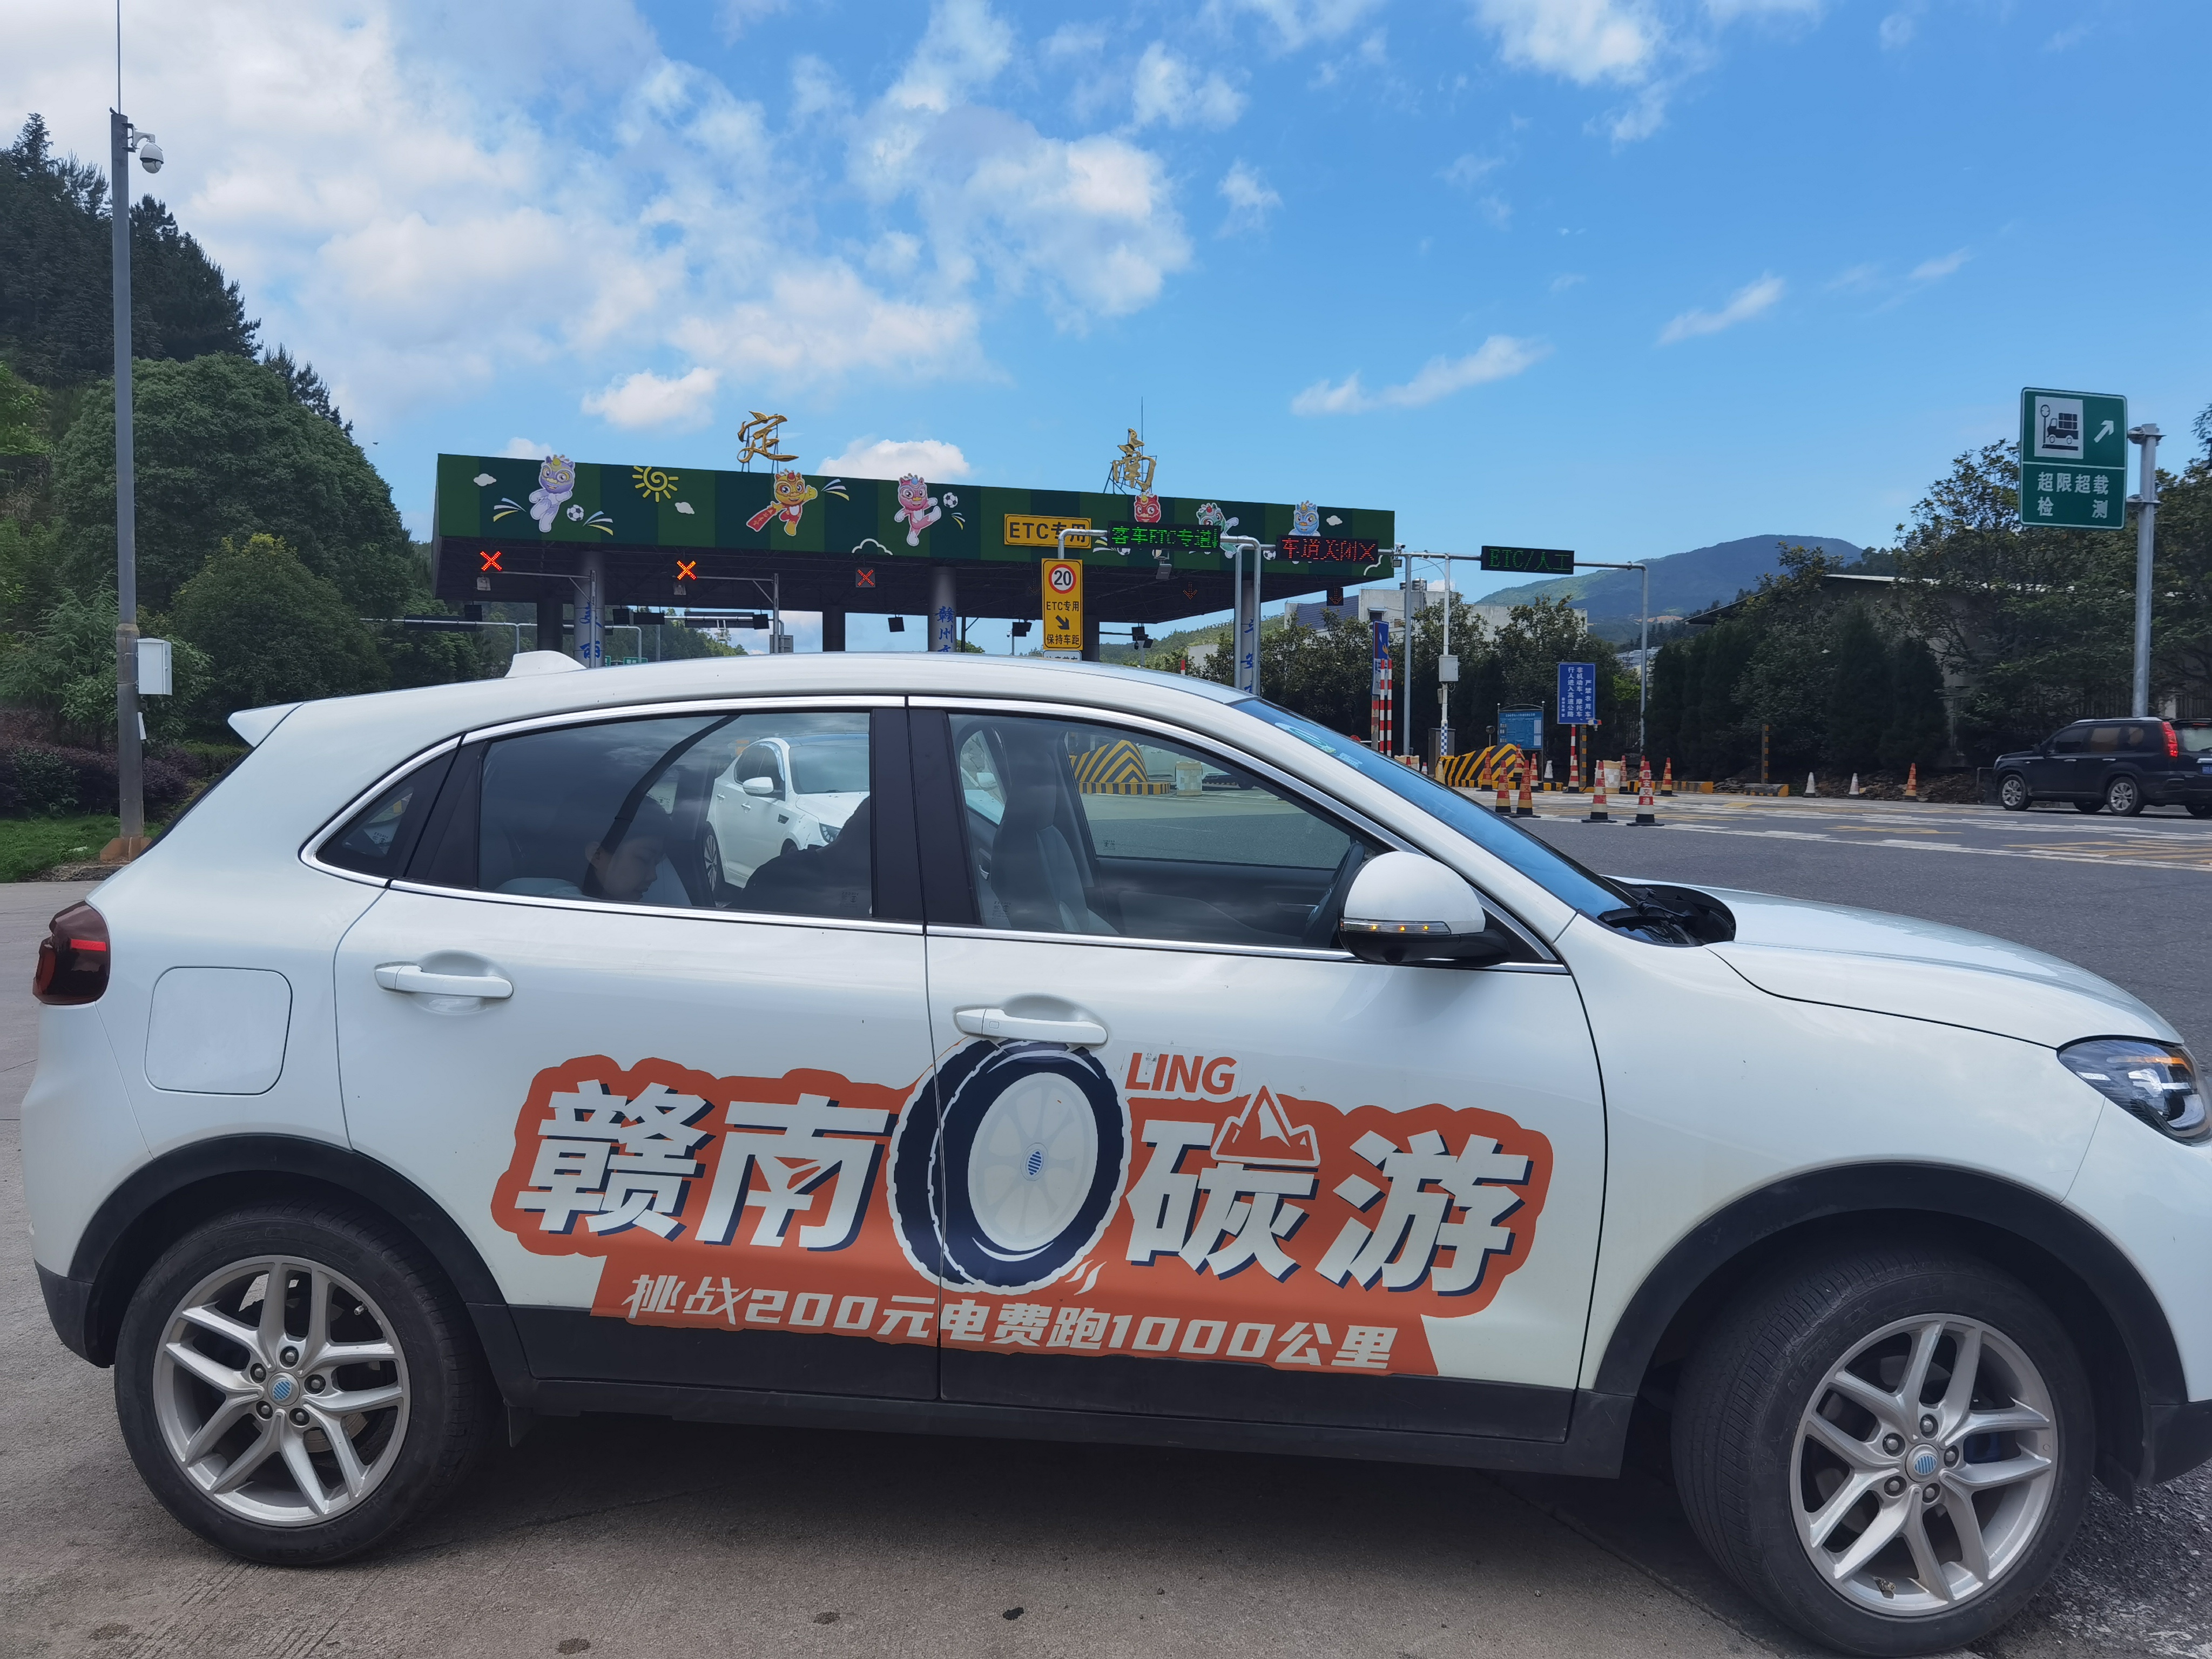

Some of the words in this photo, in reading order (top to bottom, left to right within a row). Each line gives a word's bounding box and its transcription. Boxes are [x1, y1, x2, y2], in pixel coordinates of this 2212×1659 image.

[737, 410, 800, 463] 定
[1112, 428, 1157, 492] 南
[2036, 471, 2109, 495] 超限超载
[1009, 521, 1086, 543] ETC专用
[1488, 548, 1572, 571] ETC/人工
[1054, 570, 1072, 586] 20
[1046, 600, 1080, 612] ETC专用
[1046, 633, 1080, 645] 保持车距
[1567, 666, 1575, 718] 行人进入高速公路
[1124, 1052, 1237, 1095] LING
[621, 1273, 1399, 1370] 挑战200元电费跑1000公里
